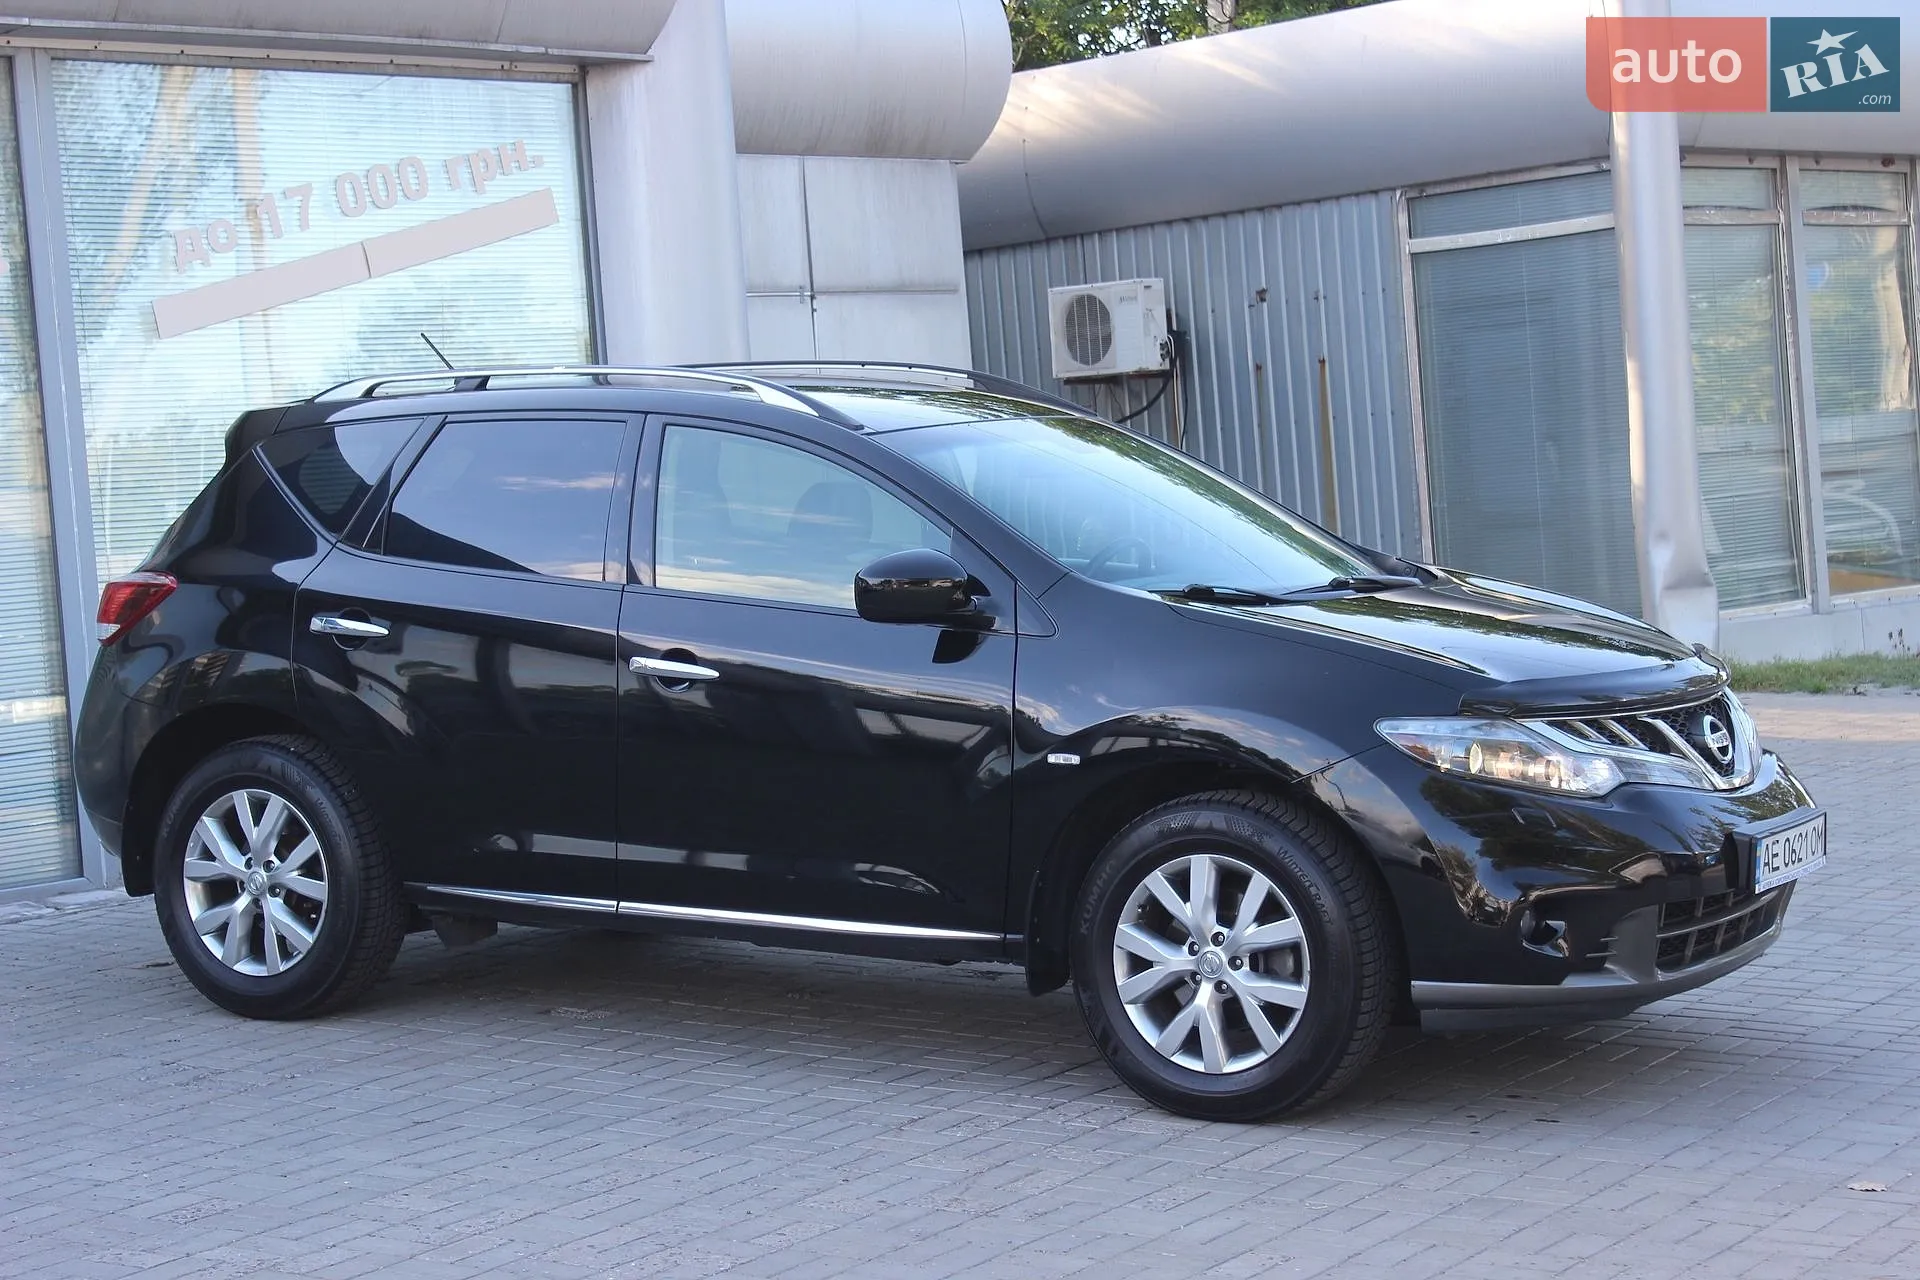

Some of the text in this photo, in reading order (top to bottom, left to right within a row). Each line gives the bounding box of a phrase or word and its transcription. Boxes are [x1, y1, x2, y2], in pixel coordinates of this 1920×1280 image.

[171, 139, 544, 274] до 17 000 грн.
[1762, 840, 1780, 875] AE
[1783, 830, 1808, 868] 0621
